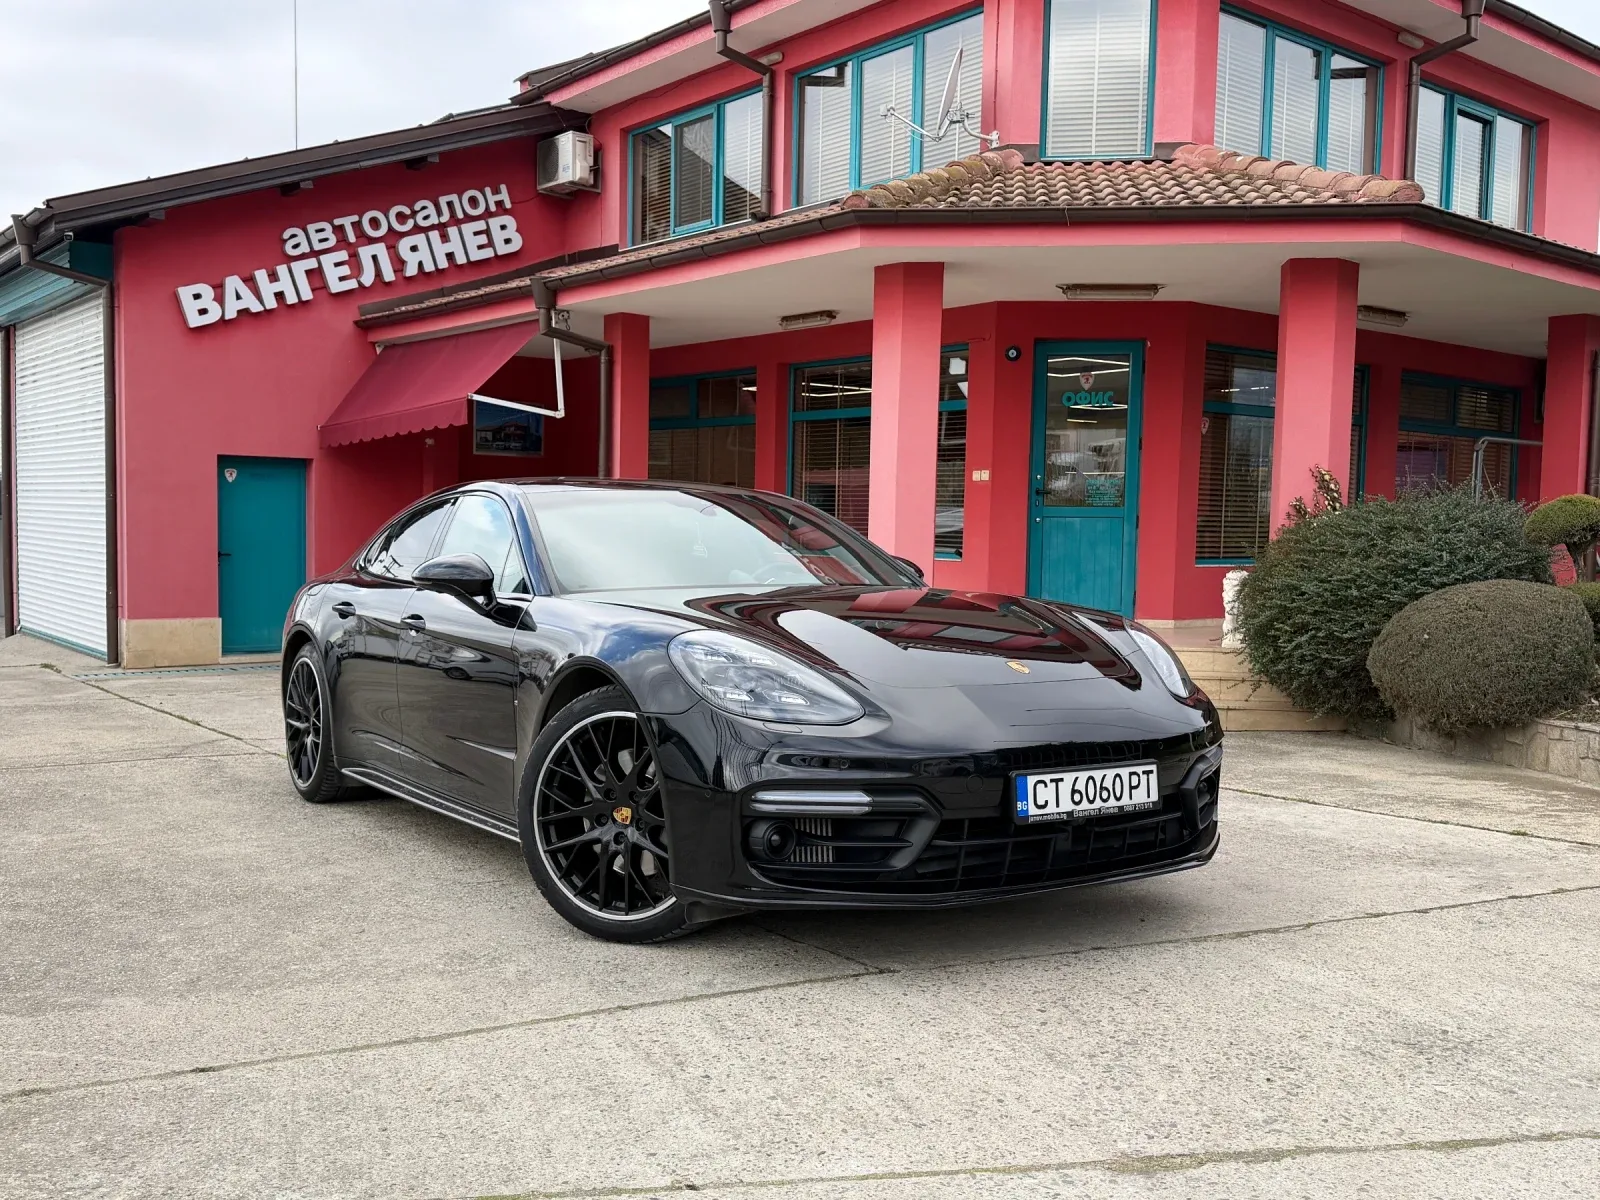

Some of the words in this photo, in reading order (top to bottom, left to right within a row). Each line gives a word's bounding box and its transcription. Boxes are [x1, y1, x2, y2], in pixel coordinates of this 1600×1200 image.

[281, 183, 512, 256] автосалон
[175, 242, 396, 328] ВАНГЕЛ
[396, 214, 523, 278] ЯНЕВ
[1062, 391, 1114, 407] ОФИС
[1033, 778, 1064, 810] CT
[1070, 773, 1124, 806] 6060
[1128, 769, 1154, 801] PT
[1016, 801, 1028, 811] BG
[1073, 809, 1099, 818] Вангел
[1100, 806, 1119, 815] Янев
